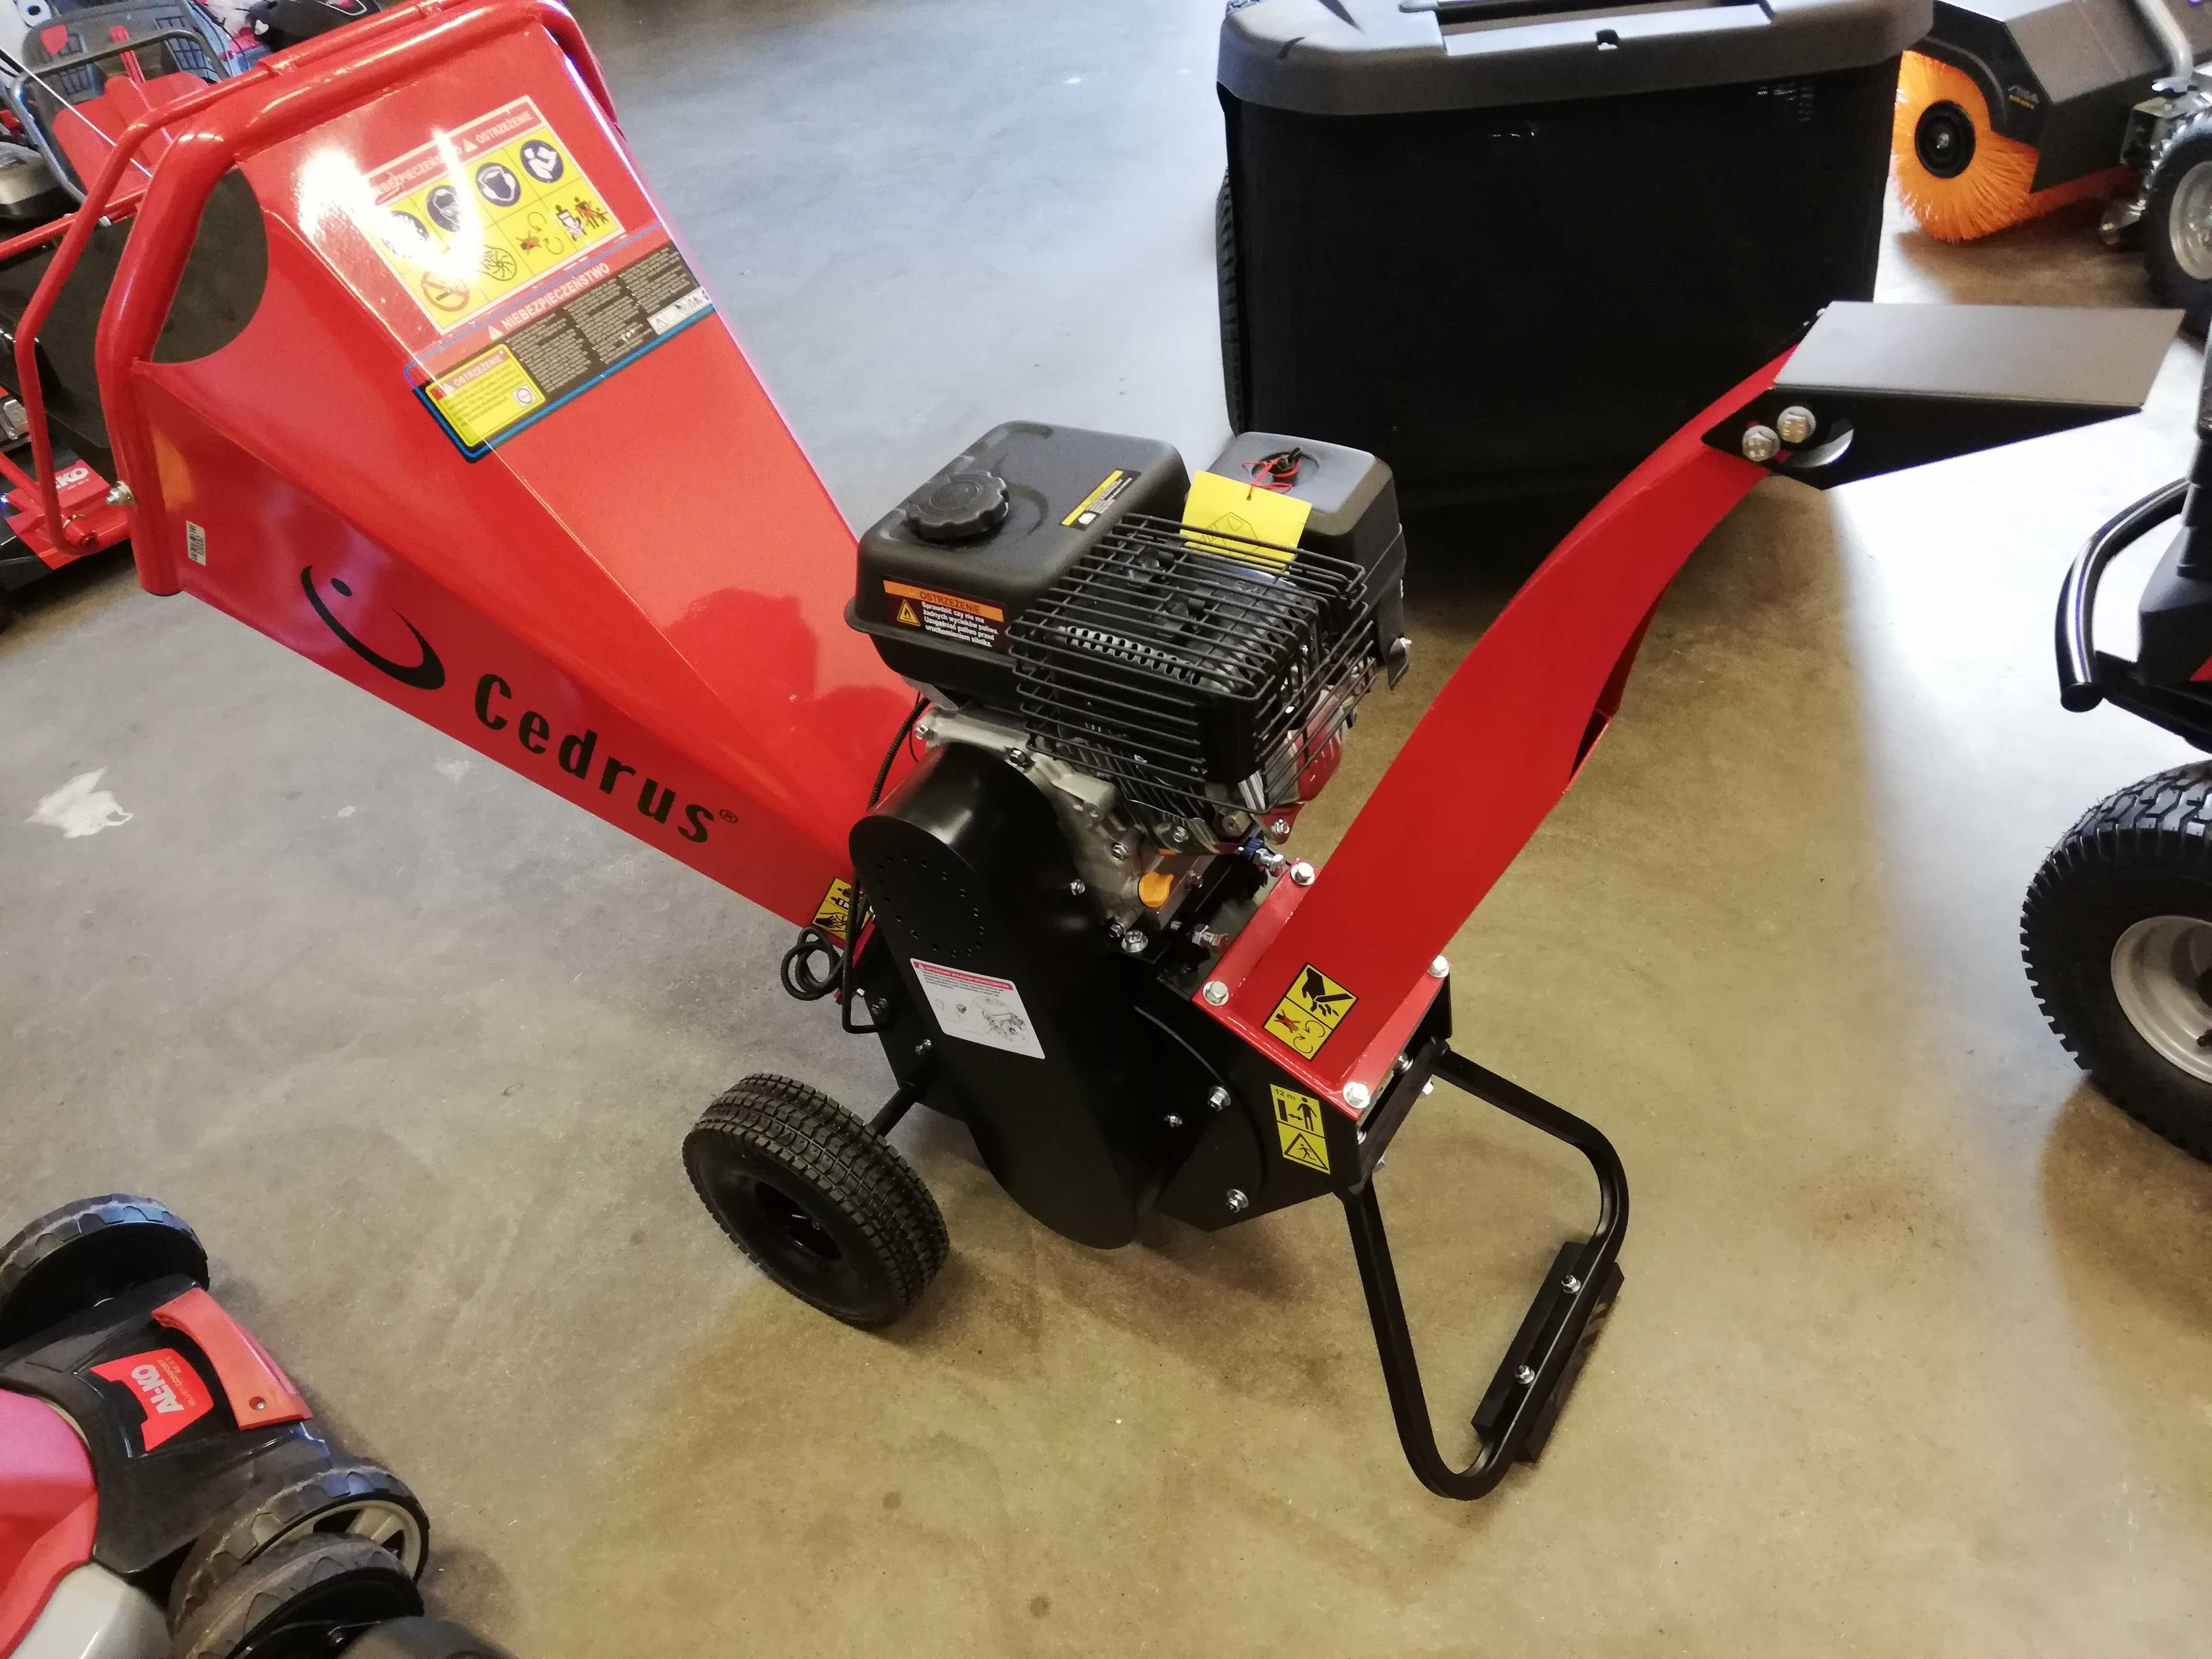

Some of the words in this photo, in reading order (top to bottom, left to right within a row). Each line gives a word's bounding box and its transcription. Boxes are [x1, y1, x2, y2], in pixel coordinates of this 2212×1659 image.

[475, 111, 533, 143] OSTRZEŻENIE
[501, 263, 610, 330] NIEBEZPIECZEŃSTWO
[453, 354, 504, 386] OSTRZEŻENIE
[920, 591, 981, 614] OSTRZEŻENIE
[953, 610, 963, 618] czy
[1275, 1089, 1285, 1097] 12
[131, 1364, 184, 1413] AL-KO
